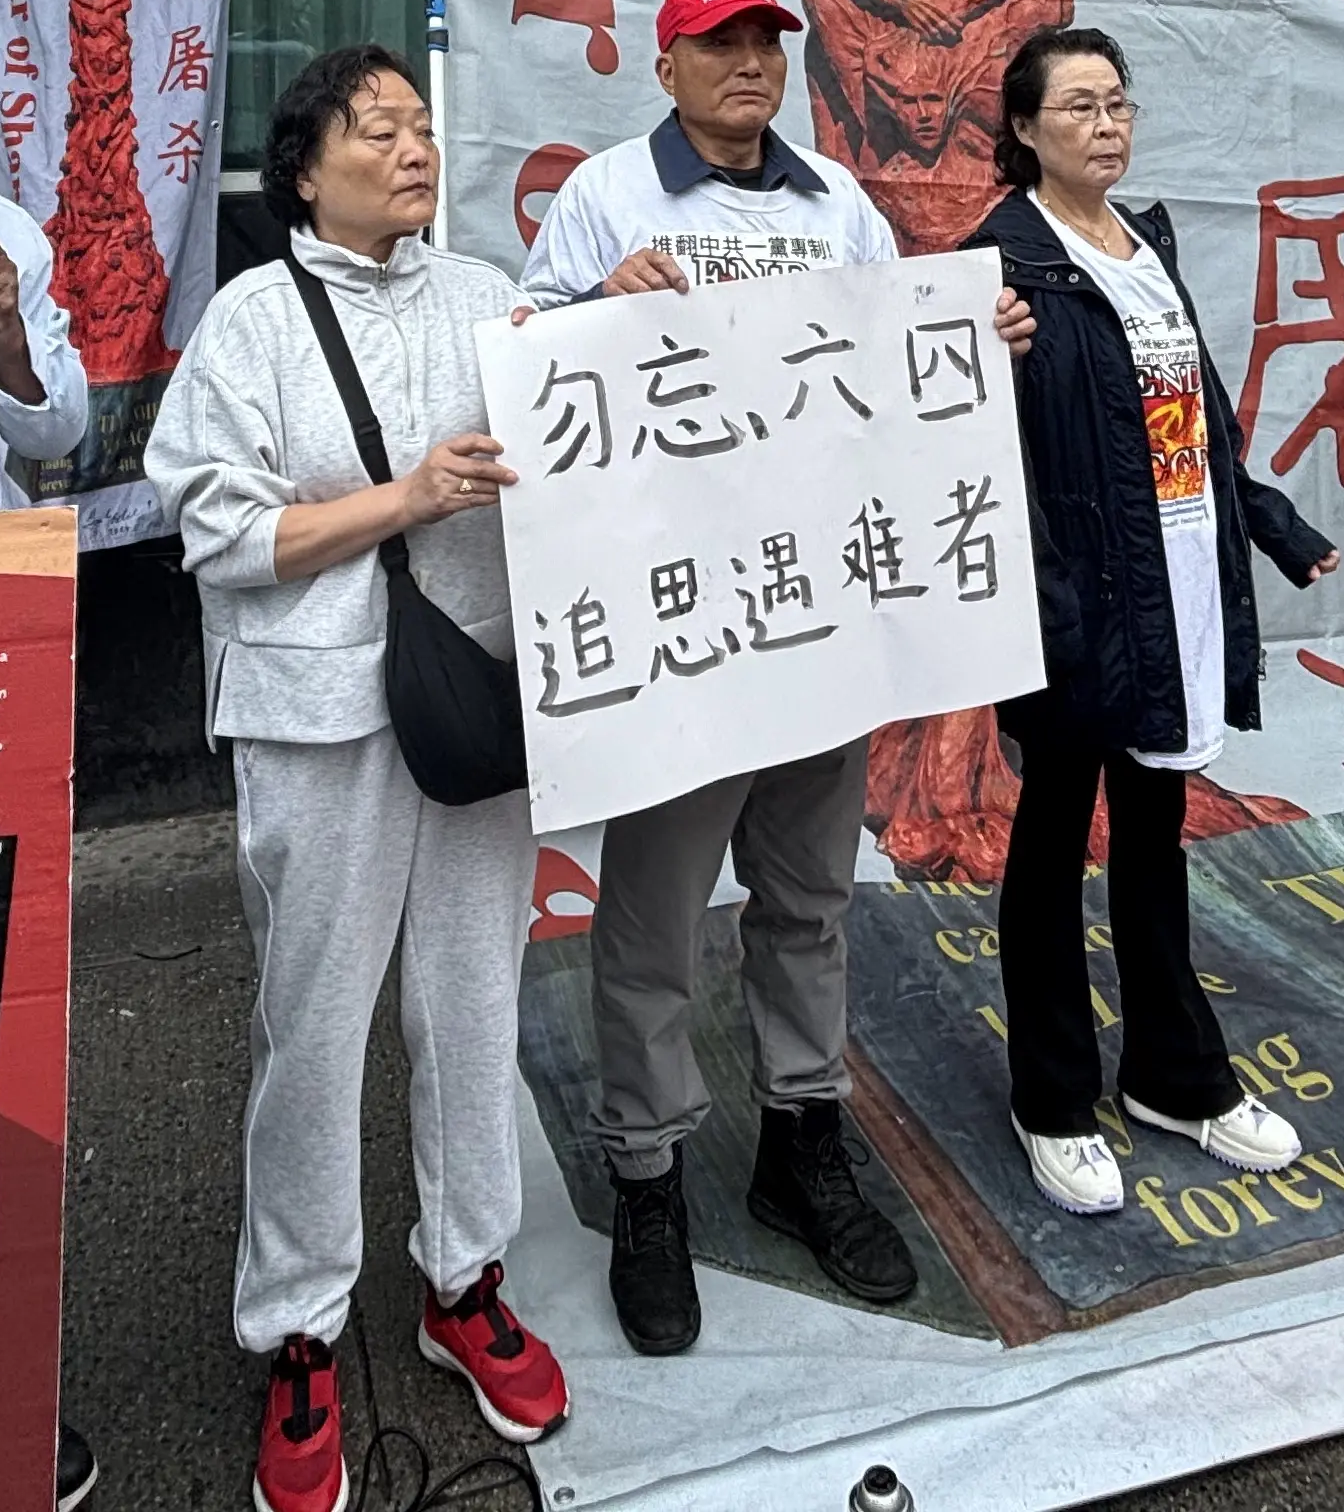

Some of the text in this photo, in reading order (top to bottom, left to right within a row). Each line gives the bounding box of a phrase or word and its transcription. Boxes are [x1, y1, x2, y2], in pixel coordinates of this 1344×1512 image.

[4, 35, 40, 81] of
[651, 233, 834, 261] 推翻中共一黨專制!
[534, 475, 1000, 717] 追思遇难者
[0, 653, 7, 662] a
